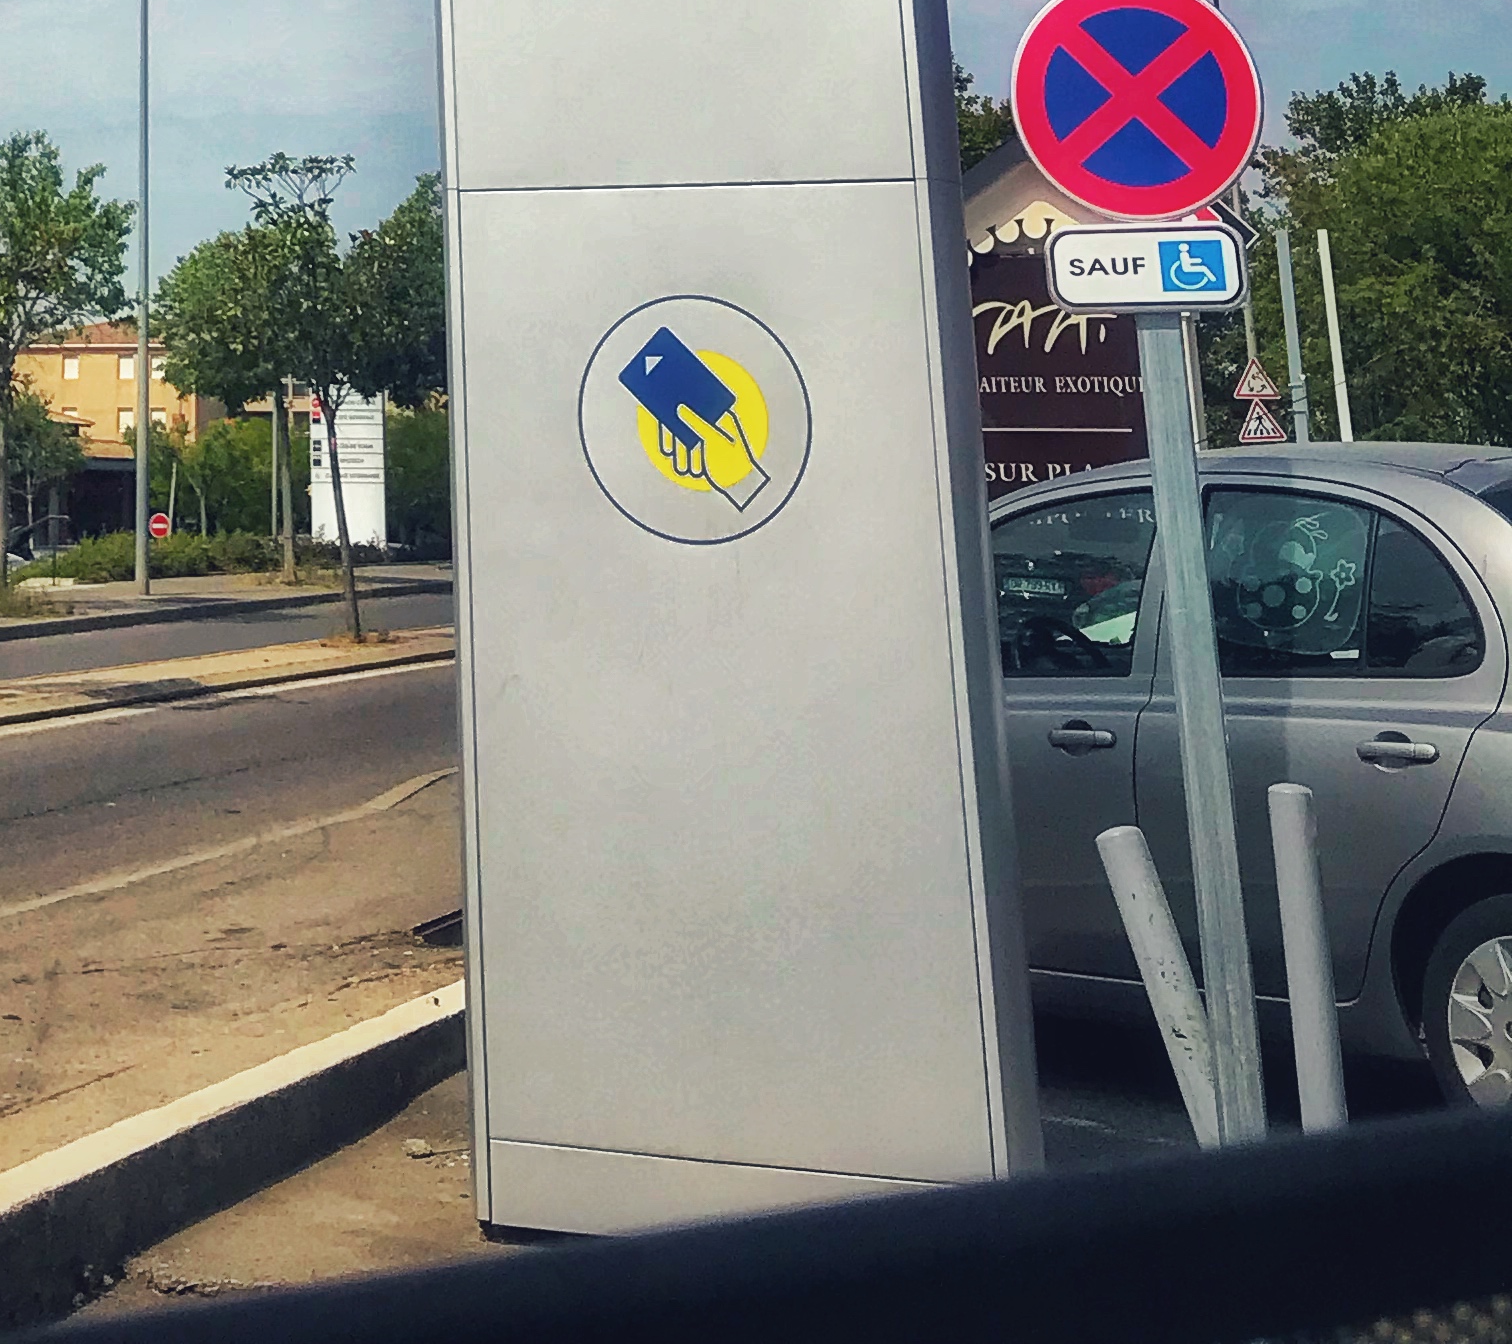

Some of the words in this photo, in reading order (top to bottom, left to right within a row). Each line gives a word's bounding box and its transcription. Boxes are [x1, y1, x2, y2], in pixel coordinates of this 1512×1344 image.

[1069, 257, 1146, 277] SAUF
[979, 376, 1047, 393] AITEUR
[984, 463, 1039, 482] SUR
